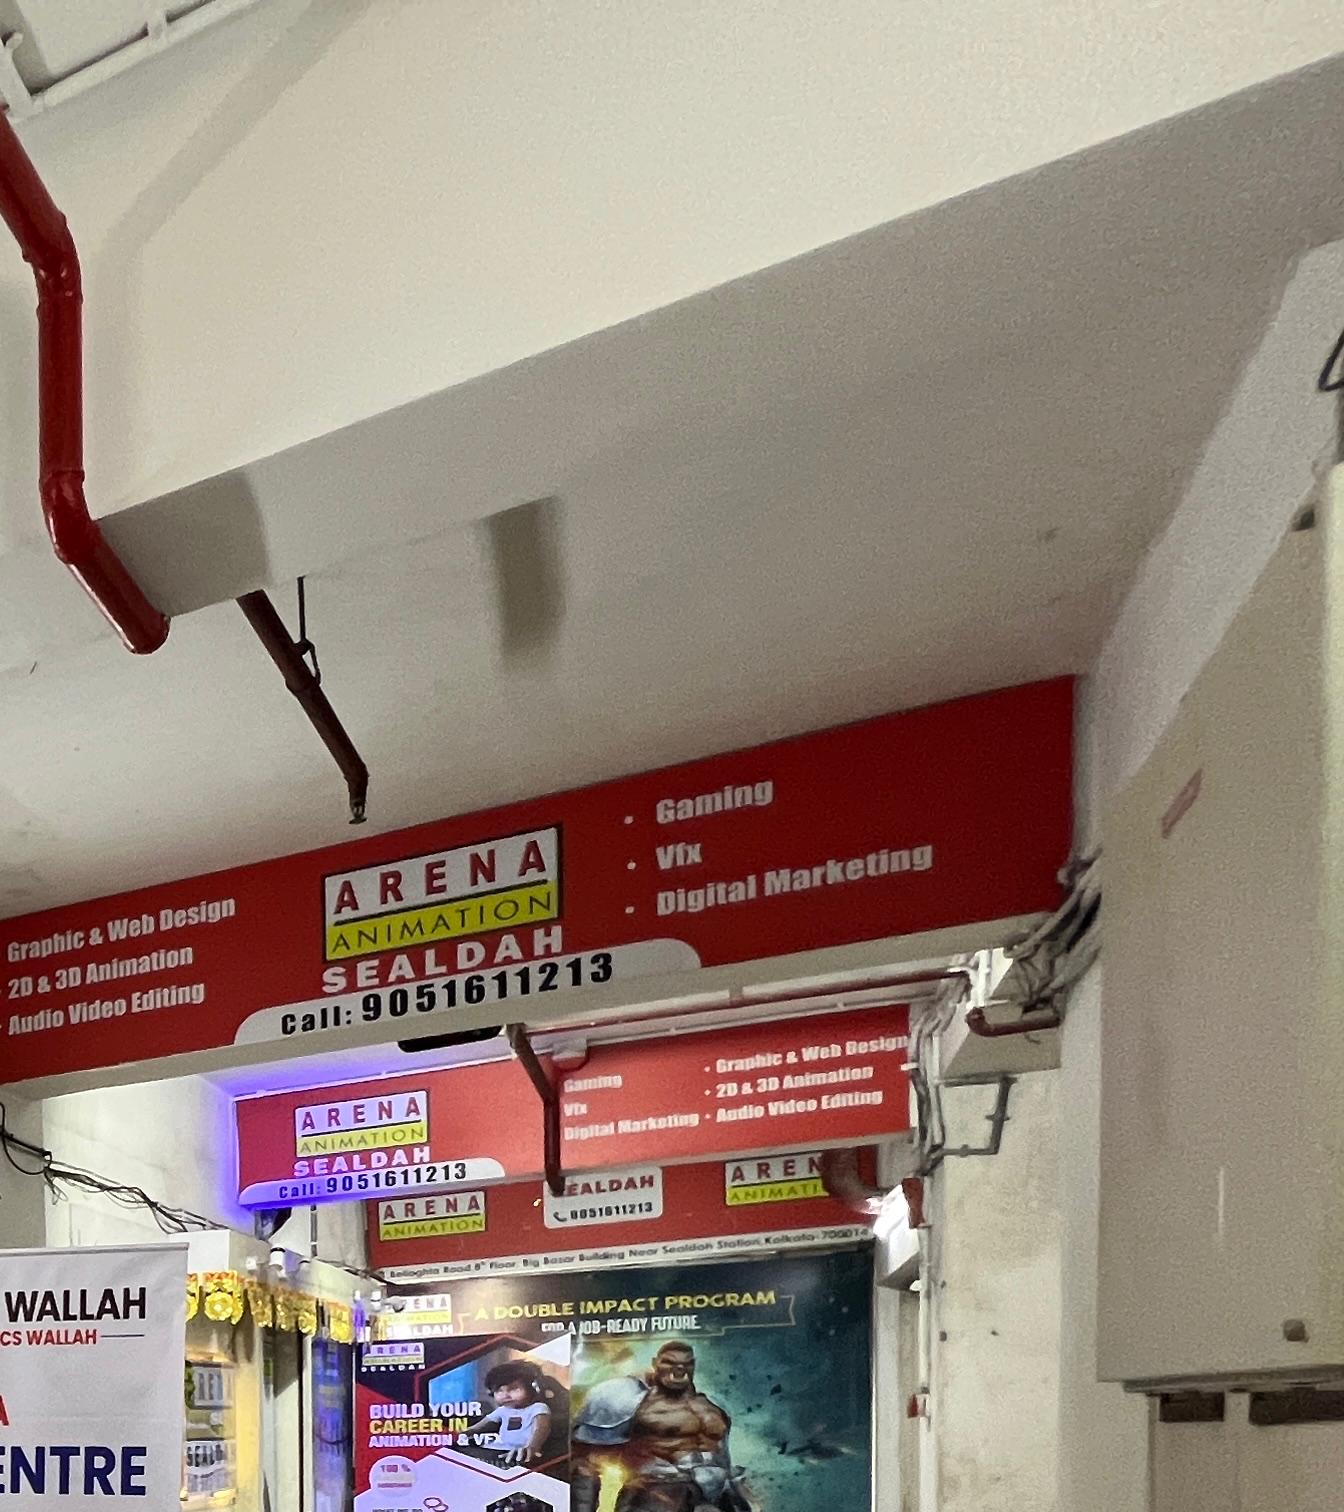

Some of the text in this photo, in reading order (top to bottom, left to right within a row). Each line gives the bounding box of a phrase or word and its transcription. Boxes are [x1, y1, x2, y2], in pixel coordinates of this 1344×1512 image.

[655, 778, 775, 825] Gaming
[655, 839, 703, 872] Vfx
[332, 839, 547, 915] ARENA
[656, 843, 934, 918] Digital Marketing
[7, 897, 236, 963] Graphic Web Design
[330, 890, 553, 953] ANIMATION
[8, 945, 194, 1000] 2D 3D Animation
[321, 924, 563, 994] SEALDAH
[361, 951, 614, 1023] 9051611213
[8, 982, 206, 1036] Audio Video Editing
[716, 1034, 909, 1075] Graphic Web Design
[563, 1074, 623, 1094] Gaming
[782, 1065, 875, 1090] Animation
[300, 1096, 421, 1131] ARENA
[715, 1090, 884, 1124] Audio Video Editing
[299, 1126, 425, 1154] ANIMATION
[563, 1111, 701, 1142] Digital Marketing
[292, 1146, 432, 1178] SEALDAH
[325, 1162, 468, 1194] 9051611213
[382, 1193, 481, 1220] ARENA
[381, 1219, 484, 1239] ANIMATION
[5, 1286, 148, 1324] WALLAH
[493, 1303, 575, 1321] DOUBLE
[578, 1296, 660, 1315] IMPACT
[664, 1290, 777, 1311] PROGRAM
[26, 1329, 98, 1347] WALLAH
[368, 1401, 482, 1420] BUILD YOUR
[368, 1416, 469, 1435] CAREER IN
[368, 1433, 454, 1449] ANIMATION
